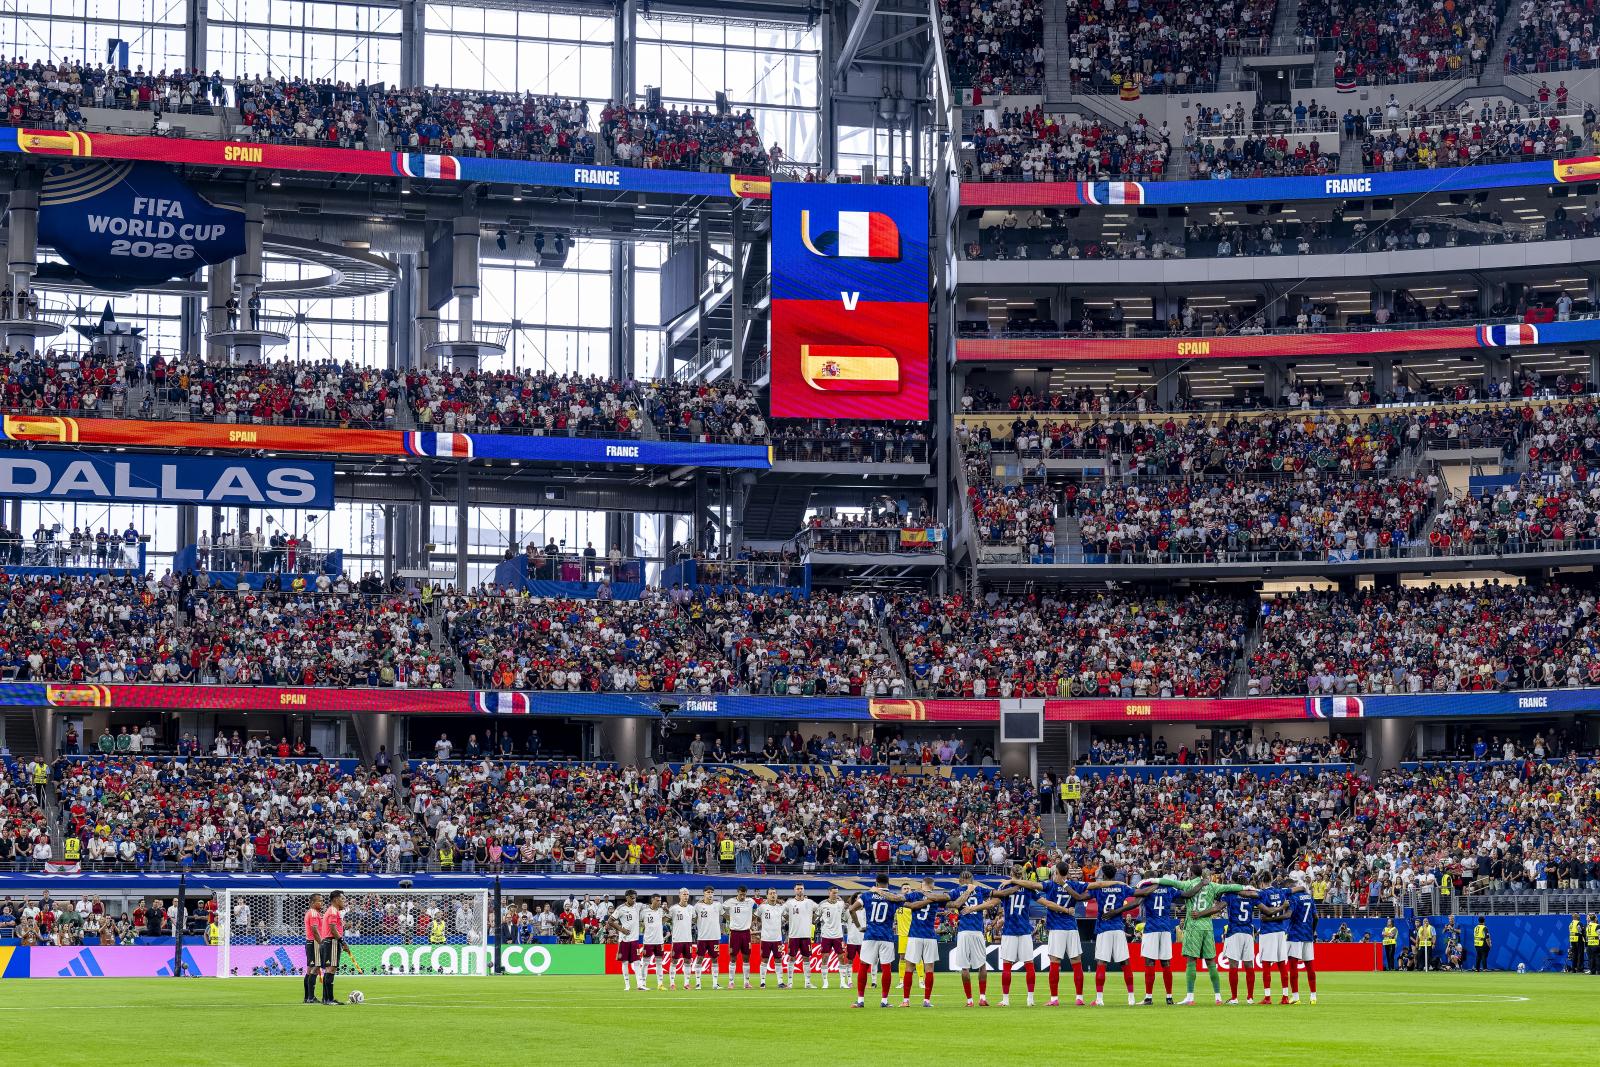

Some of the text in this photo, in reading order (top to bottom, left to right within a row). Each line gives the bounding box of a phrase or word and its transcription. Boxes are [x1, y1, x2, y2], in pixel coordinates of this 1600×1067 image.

[224, 146, 263, 163] SPAIN
[574, 168, 620, 185] FRANCE
[1325, 177, 1372, 194] FRANCE
[133, 196, 185, 219] FIFA
[87, 214, 226, 241] WORLD CUP
[110, 239, 195, 260] 2026
[1178, 341, 1210, 356] SPAIN
[229, 430, 256, 443] SPAIN
[606, 446, 639, 458] FRANCE
[0, 457, 317, 504] DALLAS
[280, 694, 306, 705] SPAIN
[686, 701, 717, 712] FRANCE
[1519, 696, 1548, 708] FRANCE
[1127, 705, 1151, 716] SPAIN
[870, 901, 889, 923] 10
[916, 903, 931, 921] 3
[1008, 894, 1025, 916] 14
[1103, 894, 1117, 914] 8
[1153, 895, 1165, 917] 4
[1238, 901, 1250, 922] 5
[1303, 902, 1312, 923] 7
[764, 912, 771, 920] 21
[381, 945, 552, 974] aramco
